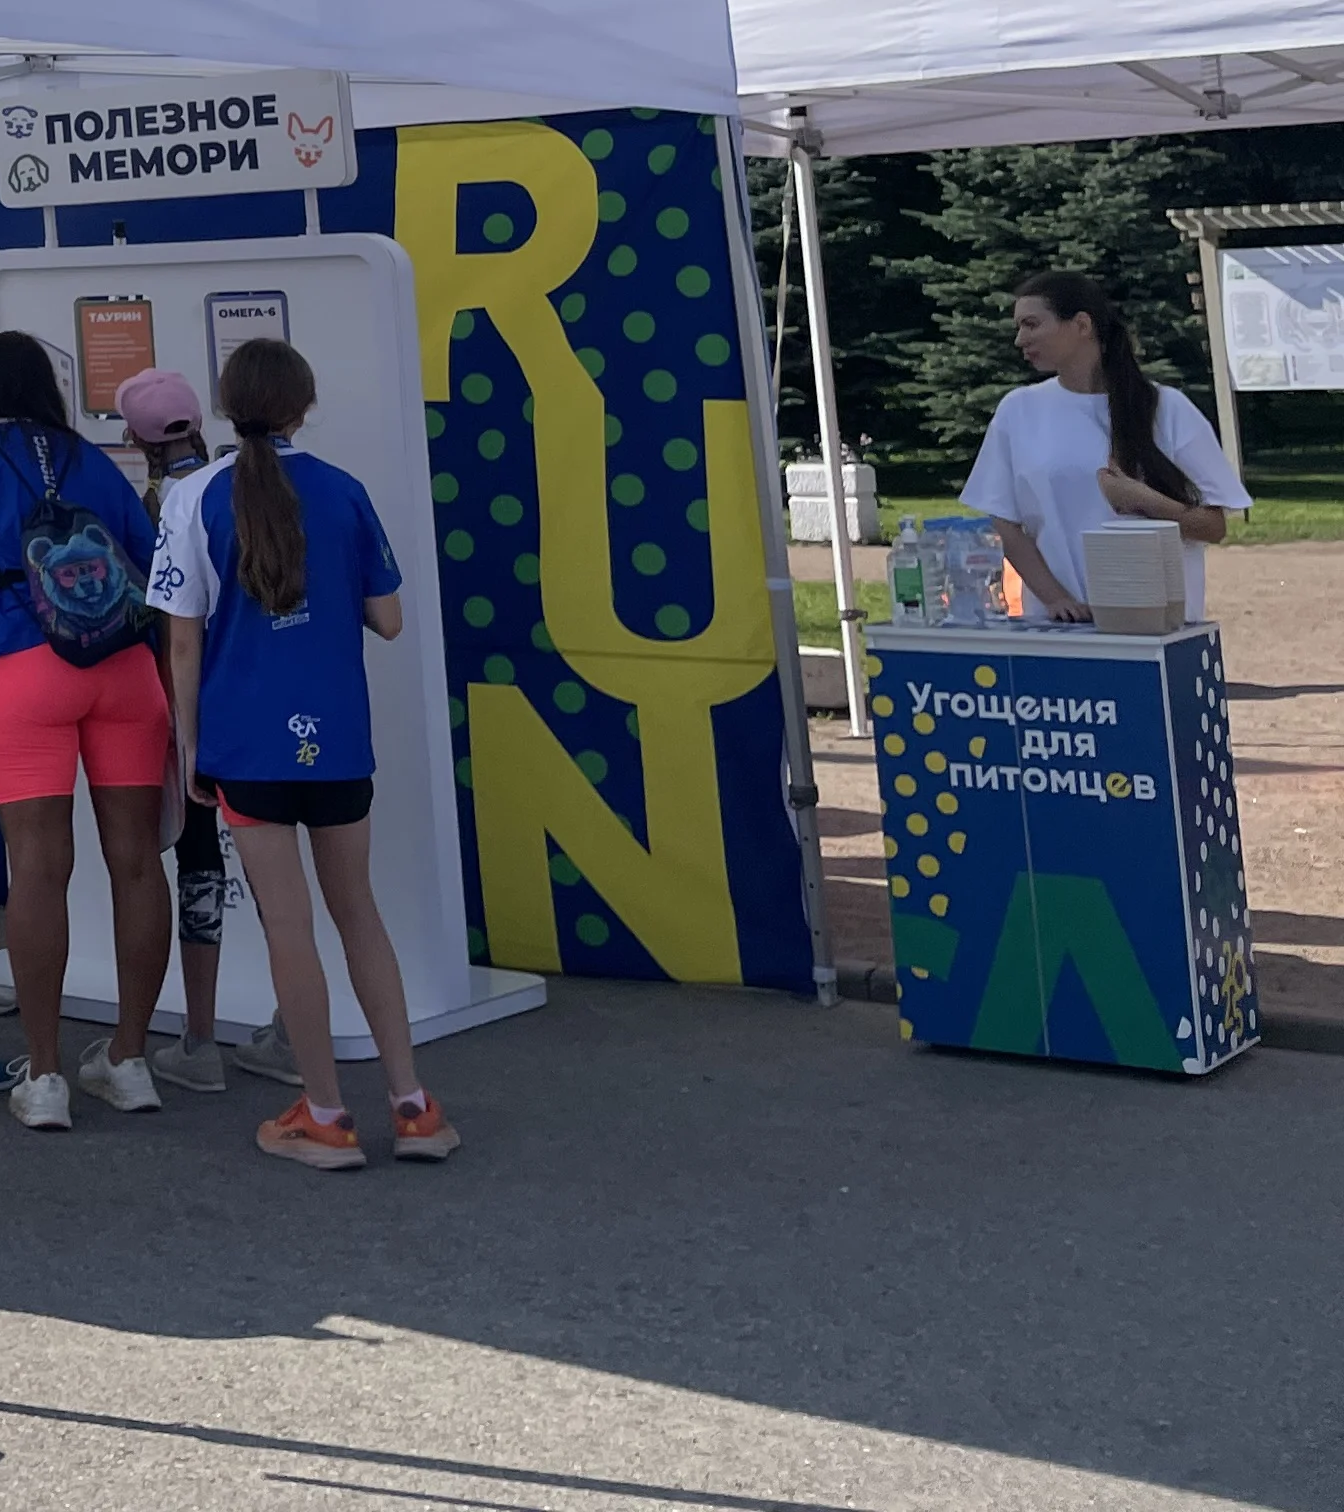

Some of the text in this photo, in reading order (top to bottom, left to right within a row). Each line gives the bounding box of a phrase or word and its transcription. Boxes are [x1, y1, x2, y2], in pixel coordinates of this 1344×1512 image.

[45, 94, 279, 144] ПОЛЕЗНОЕ
[69, 138, 259, 183] МЕМОРИ
[89, 311, 142, 323] ТАУРИН
[218, 307, 276, 319] ОМЕГА-6
[906, 681, 1118, 726] Угощения
[1021, 729, 1097, 760] для
[949, 762, 1156, 803] питомцев
